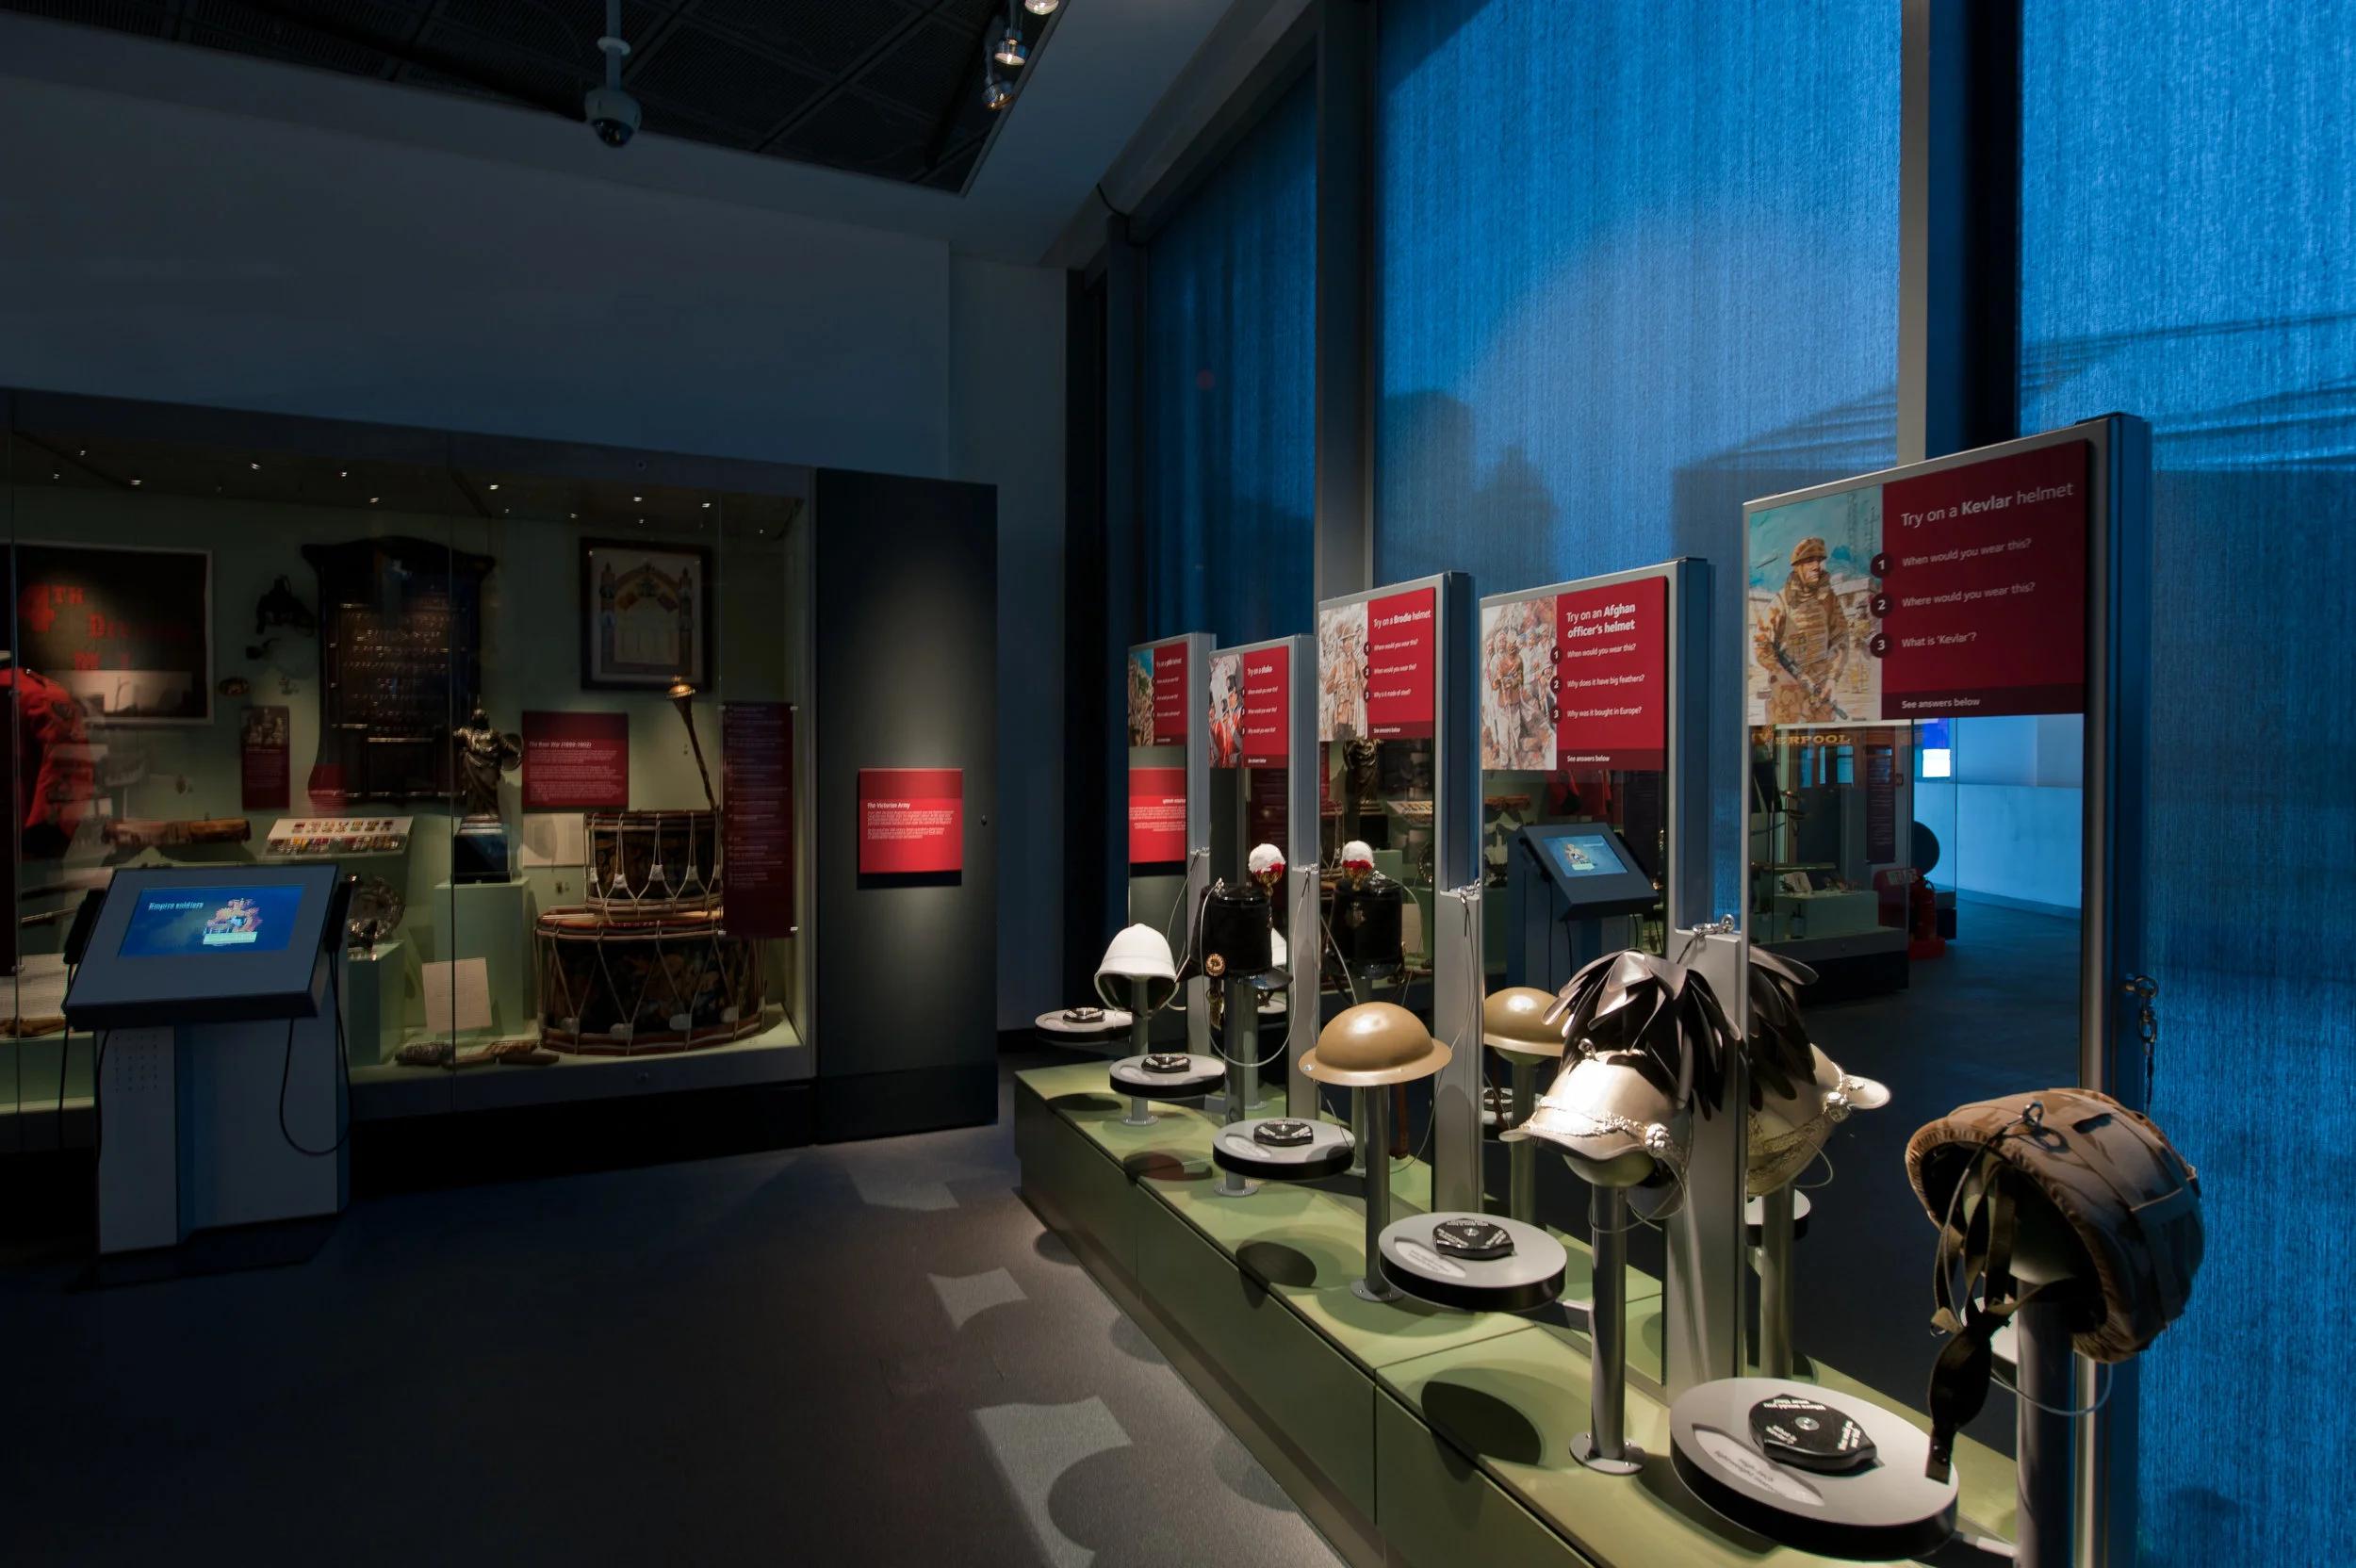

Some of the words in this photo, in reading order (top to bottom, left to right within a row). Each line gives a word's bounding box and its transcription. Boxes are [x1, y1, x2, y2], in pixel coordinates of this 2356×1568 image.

[1900, 512, 1923, 529] Try
[1926, 508, 1945, 522] on
[1948, 506, 1957, 517] a
[1960, 494, 2013, 515] Kevlar
[2016, 482, 2074, 505] helmet
[1877, 559, 1886, 570] 1
[1902, 555, 1929, 566] When
[1930, 549, 1957, 563] would
[1959, 549, 1979, 561] you
[1980, 544, 2005, 555] wear
[2006, 537, 2033, 551] this?
[1877, 599, 1886, 611] 2
[1902, 595, 1931, 608] Where
[1934, 591, 1961, 604] would
[1963, 590, 1982, 602] you
[1984, 586, 2009, 597] wear
[2011, 581, 2036, 594] this?
[1373, 618, 1382, 629] Try
[1383, 618, 1390, 627] on
[1394, 612, 1412, 624] Brodie
[1412, 610, 1432, 621] helmet
[1566, 612, 1579, 625] Try
[1580, 611, 1591, 620] on
[1592, 609, 1602, 619] an
[1603, 602, 1636, 618] Afghan
[1567, 624, 1602, 639] officer's
[1604, 619, 1636, 633] helmet
[1554, 650, 1559, 659] 1
[1567, 650, 1581, 659] When
[1582, 646, 1597, 656] would
[1597, 648, 1608, 657] you
[1623, 643, 1637, 651] this?
[1876, 639, 1886, 651] 3
[1902, 636, 1925, 647] What
[1927, 636, 1935, 645] is
[1554, 679, 1559, 689] 2
[1567, 680, 1579, 689] Why
[1596, 678, 1609, 686] have
[1610, 677, 1619, 686] big
[1619, 674, 1645, 683] feathers?
[1902, 700, 1917, 710] See
[1918, 699, 1952, 709] answers
[1954, 697, 1980, 707] below
[1554, 710, 1559, 718] 3
[1567, 710, 1579, 719] Why
[1595, 708, 1612, 718] bought
[1620, 706, 1643, 716] Europe?
[148, 902, 175, 911] Empire
[175, 901, 204, 909] soldiers
